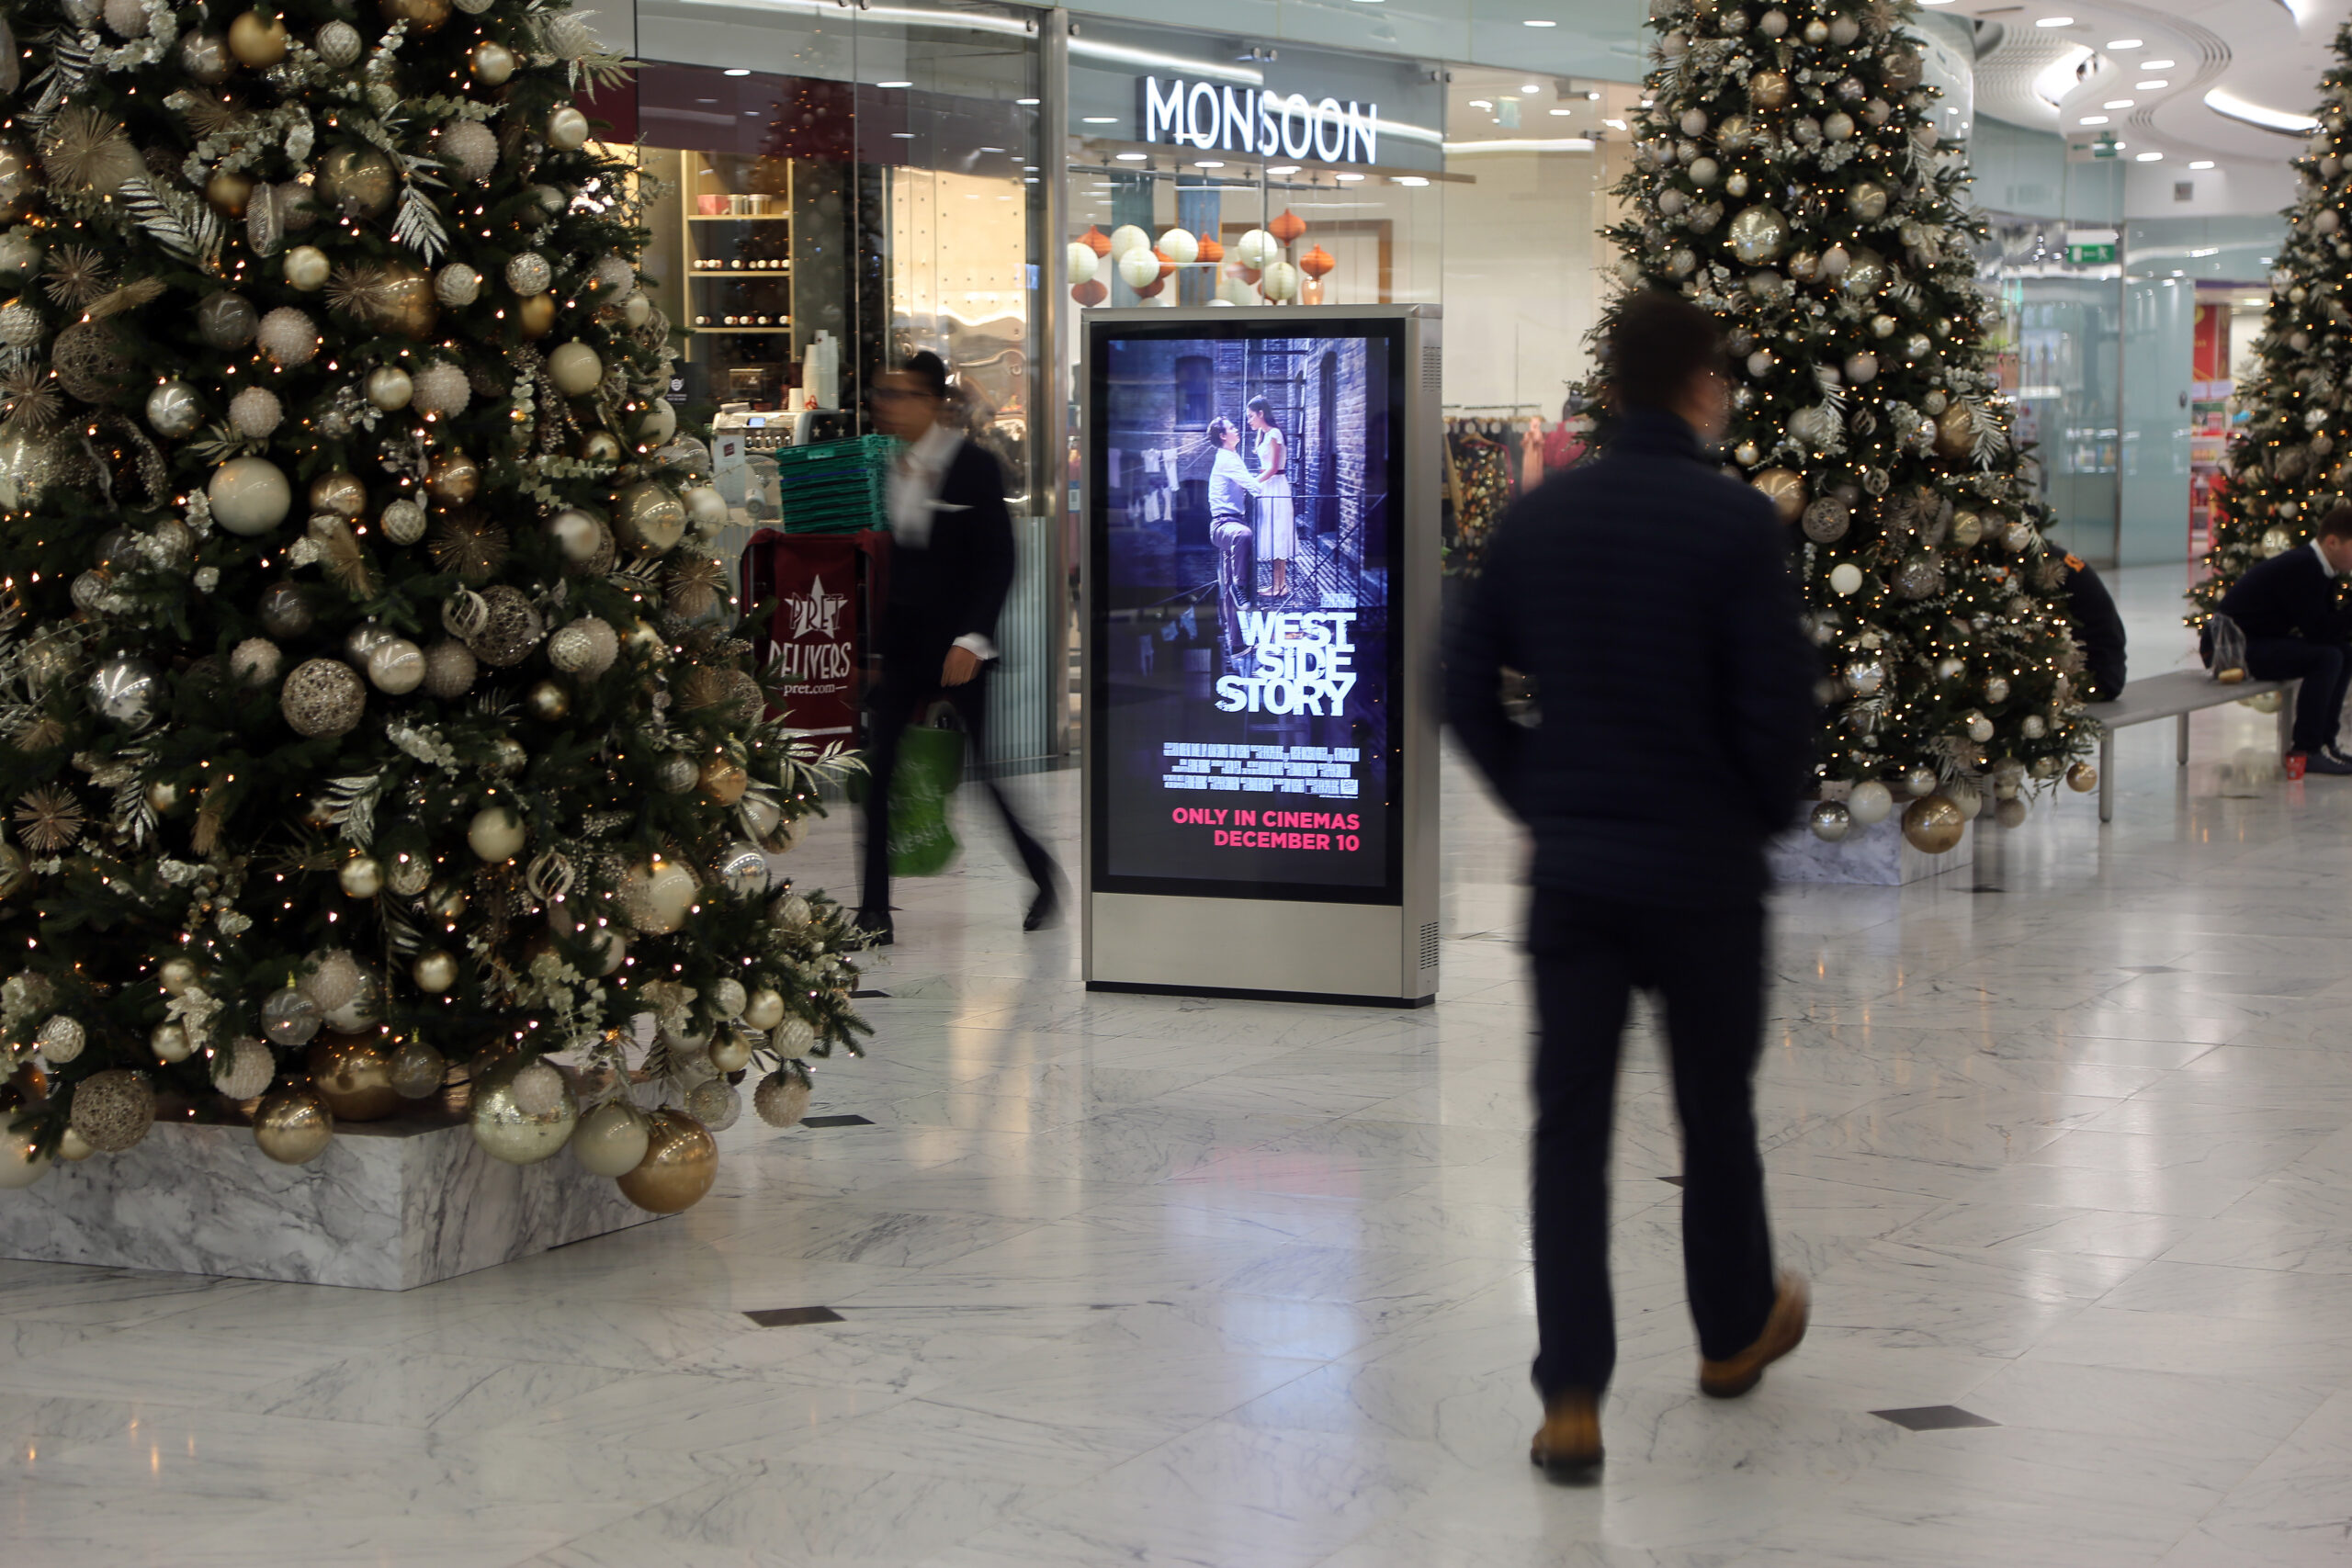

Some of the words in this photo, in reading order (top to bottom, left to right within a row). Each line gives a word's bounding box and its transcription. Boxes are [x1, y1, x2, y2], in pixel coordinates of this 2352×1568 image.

[1145, 75, 1377, 164] MONSOON
[789, 592, 844, 631] PRET
[1236, 610, 1357, 647] WEST
[768, 639, 852, 681] DELIVERS
[1251, 643, 1356, 681] SIDE
[783, 683, 836, 697] pret.com
[1214, 674, 1357, 716] STORY
[1171, 807, 1229, 826] ONLY
[1234, 809, 1257, 827] IN
[1261, 810, 1361, 830] CINEMAS
[1214, 829, 1330, 851] DECEMBER
[1336, 834, 1360, 852] 10
